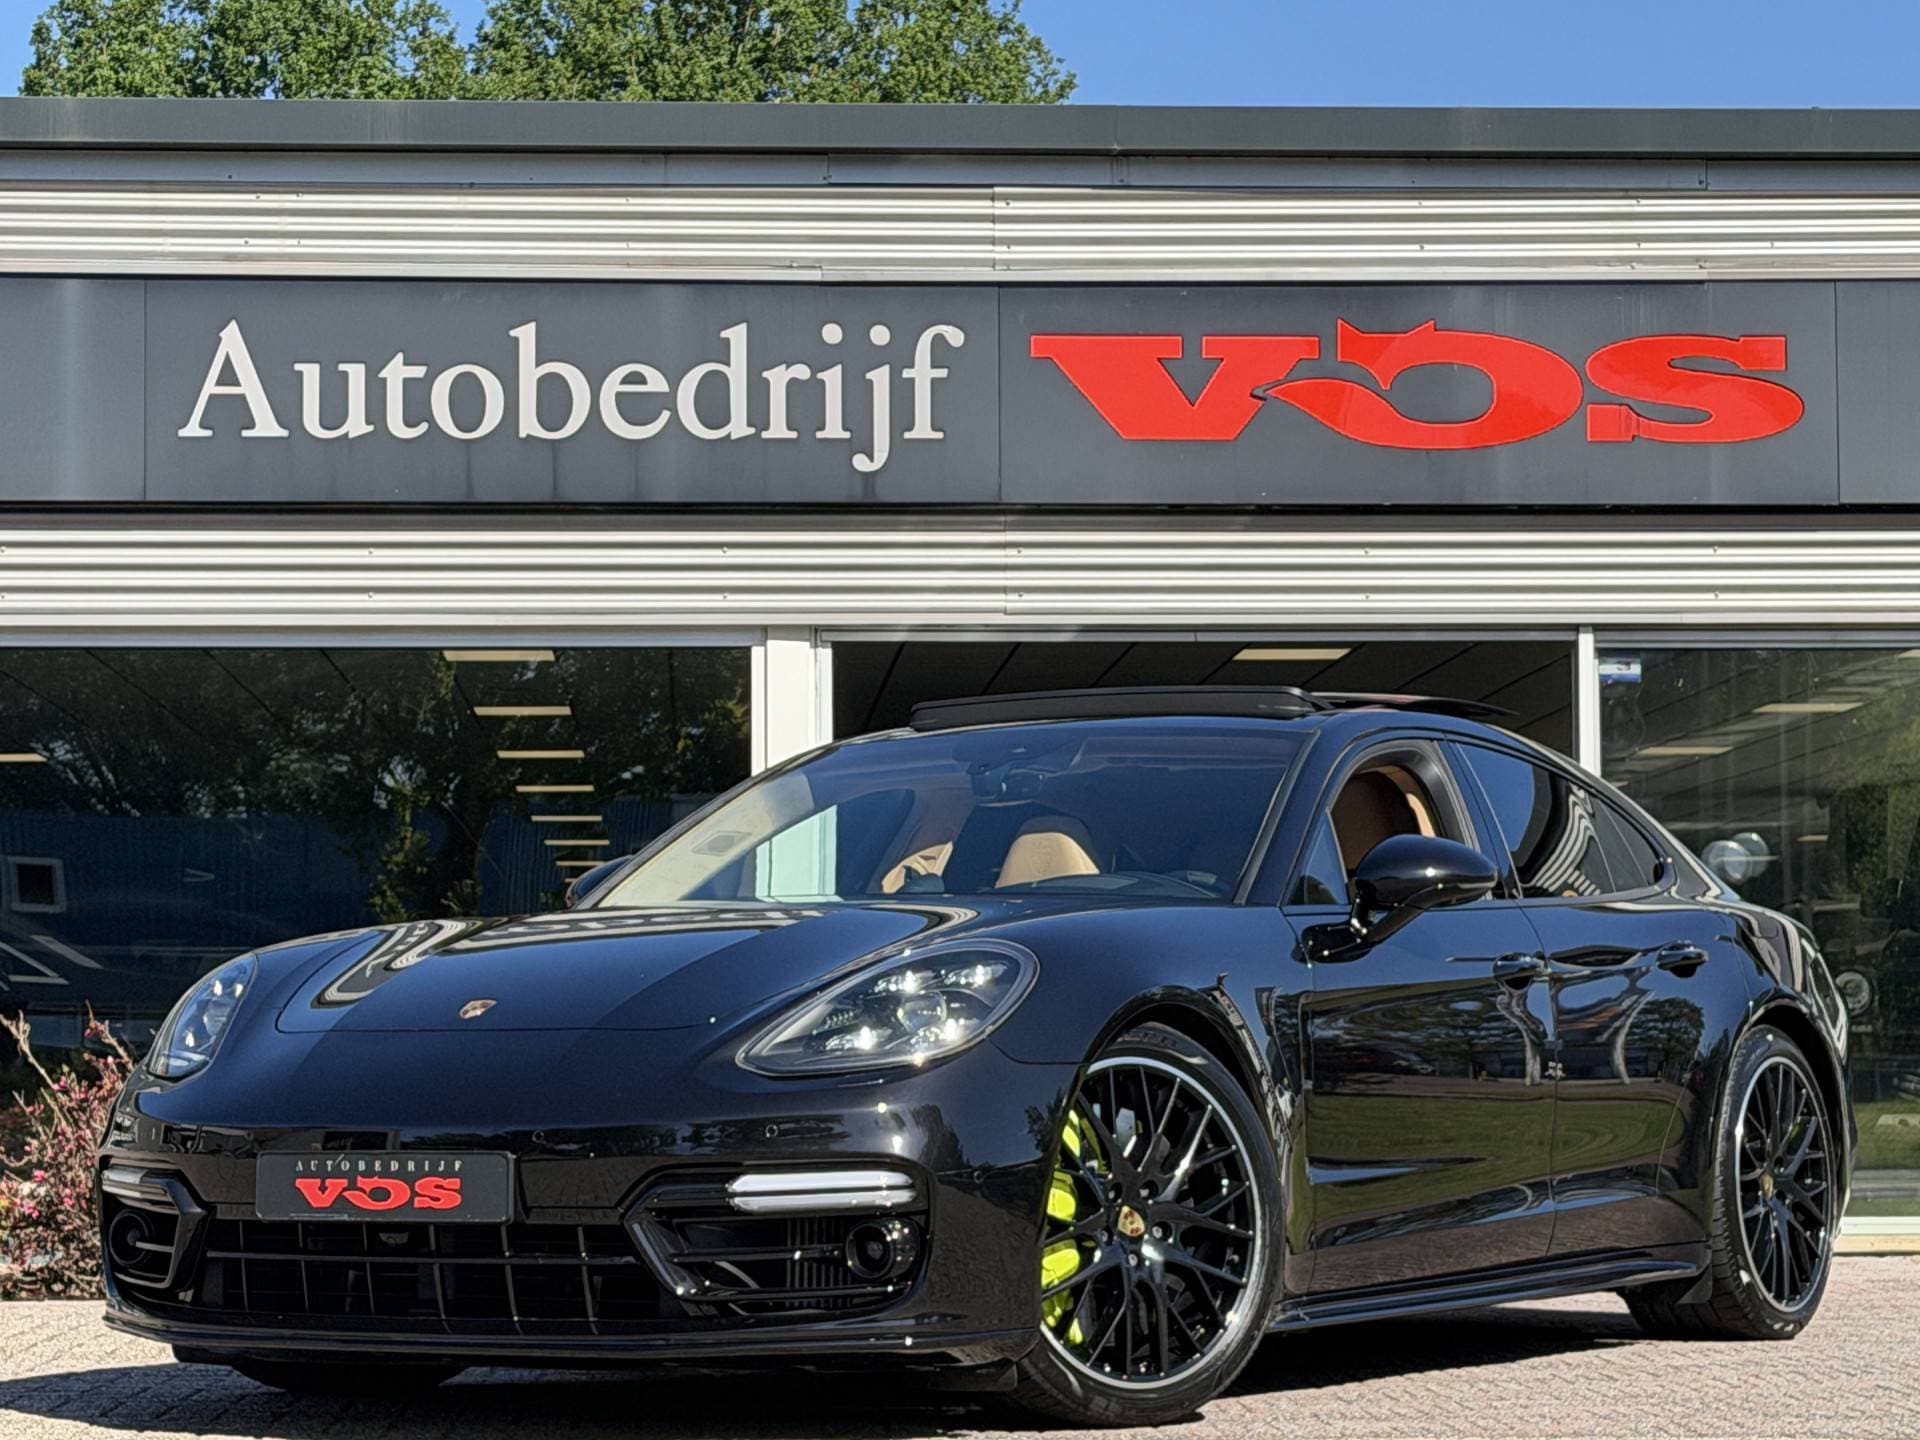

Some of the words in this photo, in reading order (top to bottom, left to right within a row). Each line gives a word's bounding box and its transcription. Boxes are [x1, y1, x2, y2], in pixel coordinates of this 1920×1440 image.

[177, 319, 966, 473] Autobedrijf
[1029, 318, 1806, 451] VOS
[295, 1158, 463, 1173] AUTOBEDRIJF
[295, 1175, 463, 1211] VOS
